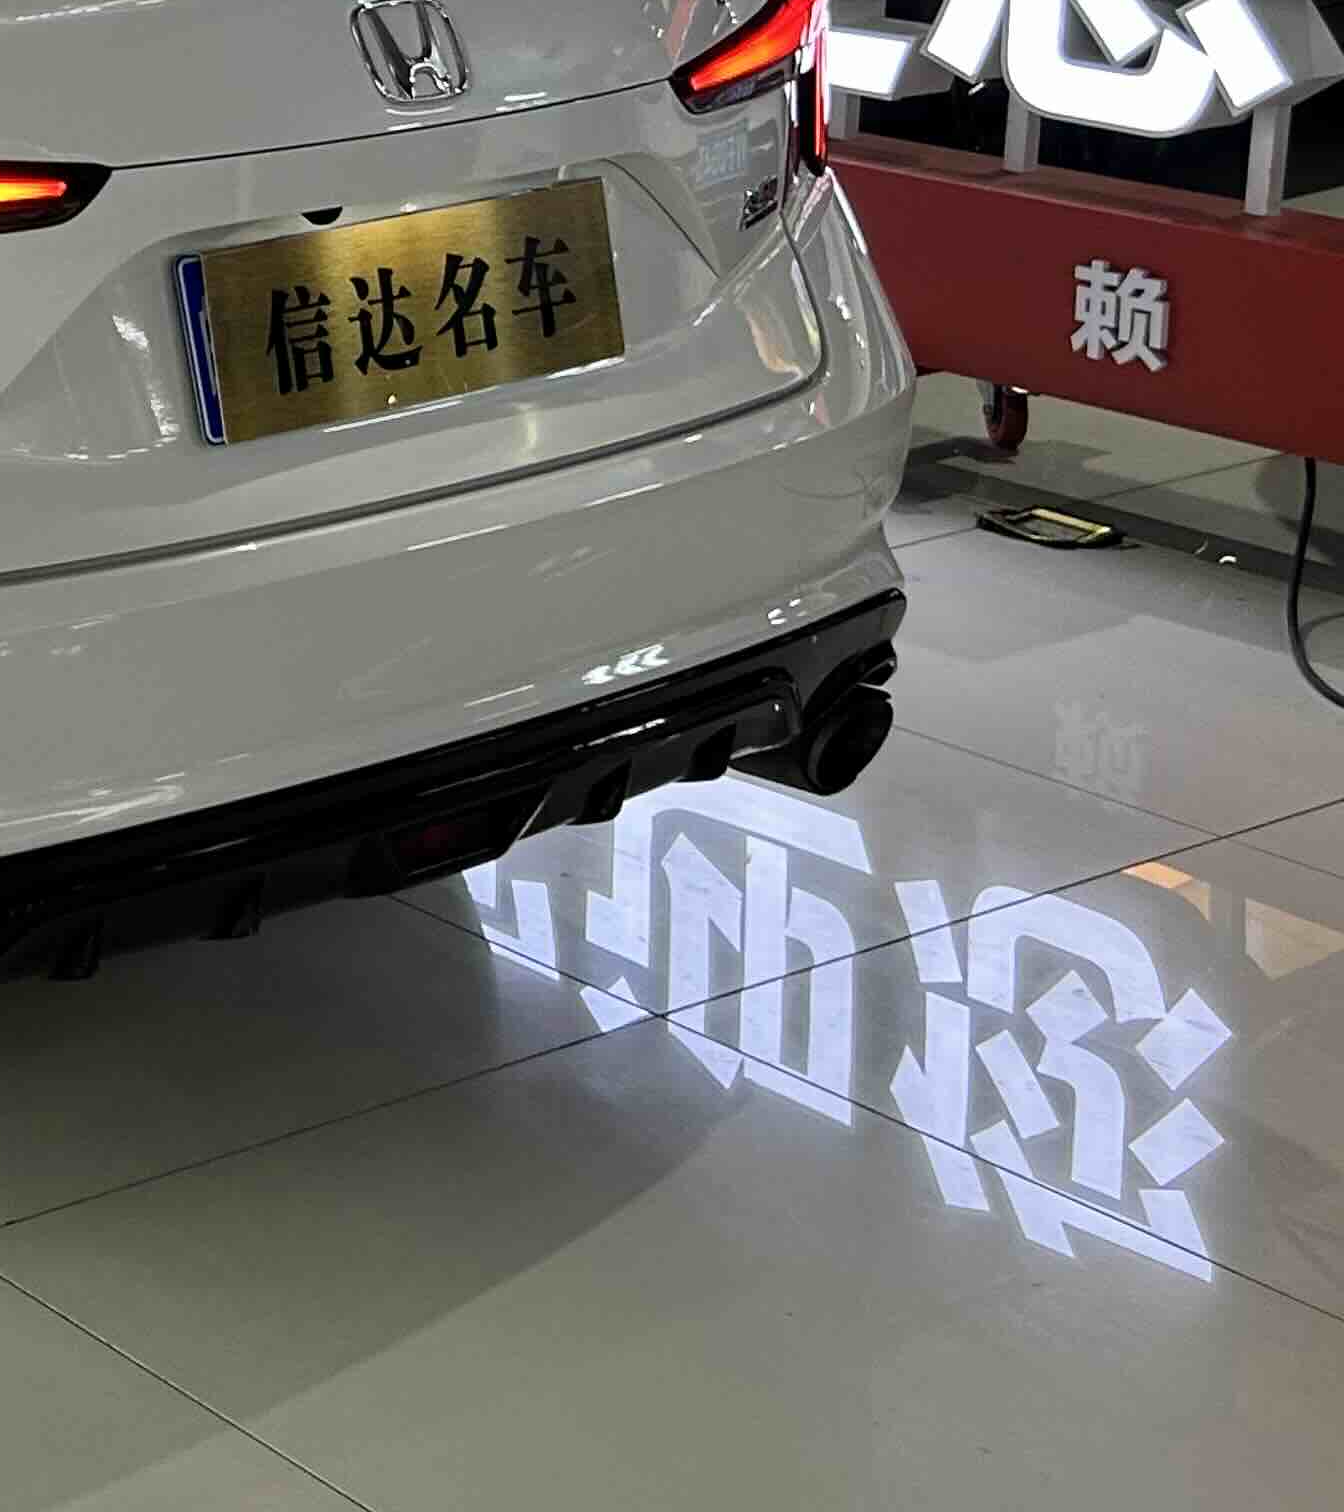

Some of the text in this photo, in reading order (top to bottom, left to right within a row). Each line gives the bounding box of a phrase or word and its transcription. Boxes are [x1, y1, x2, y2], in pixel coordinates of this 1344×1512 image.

[266, 235, 577, 396] 信达名车
[1071, 259, 1171, 373] 赖
